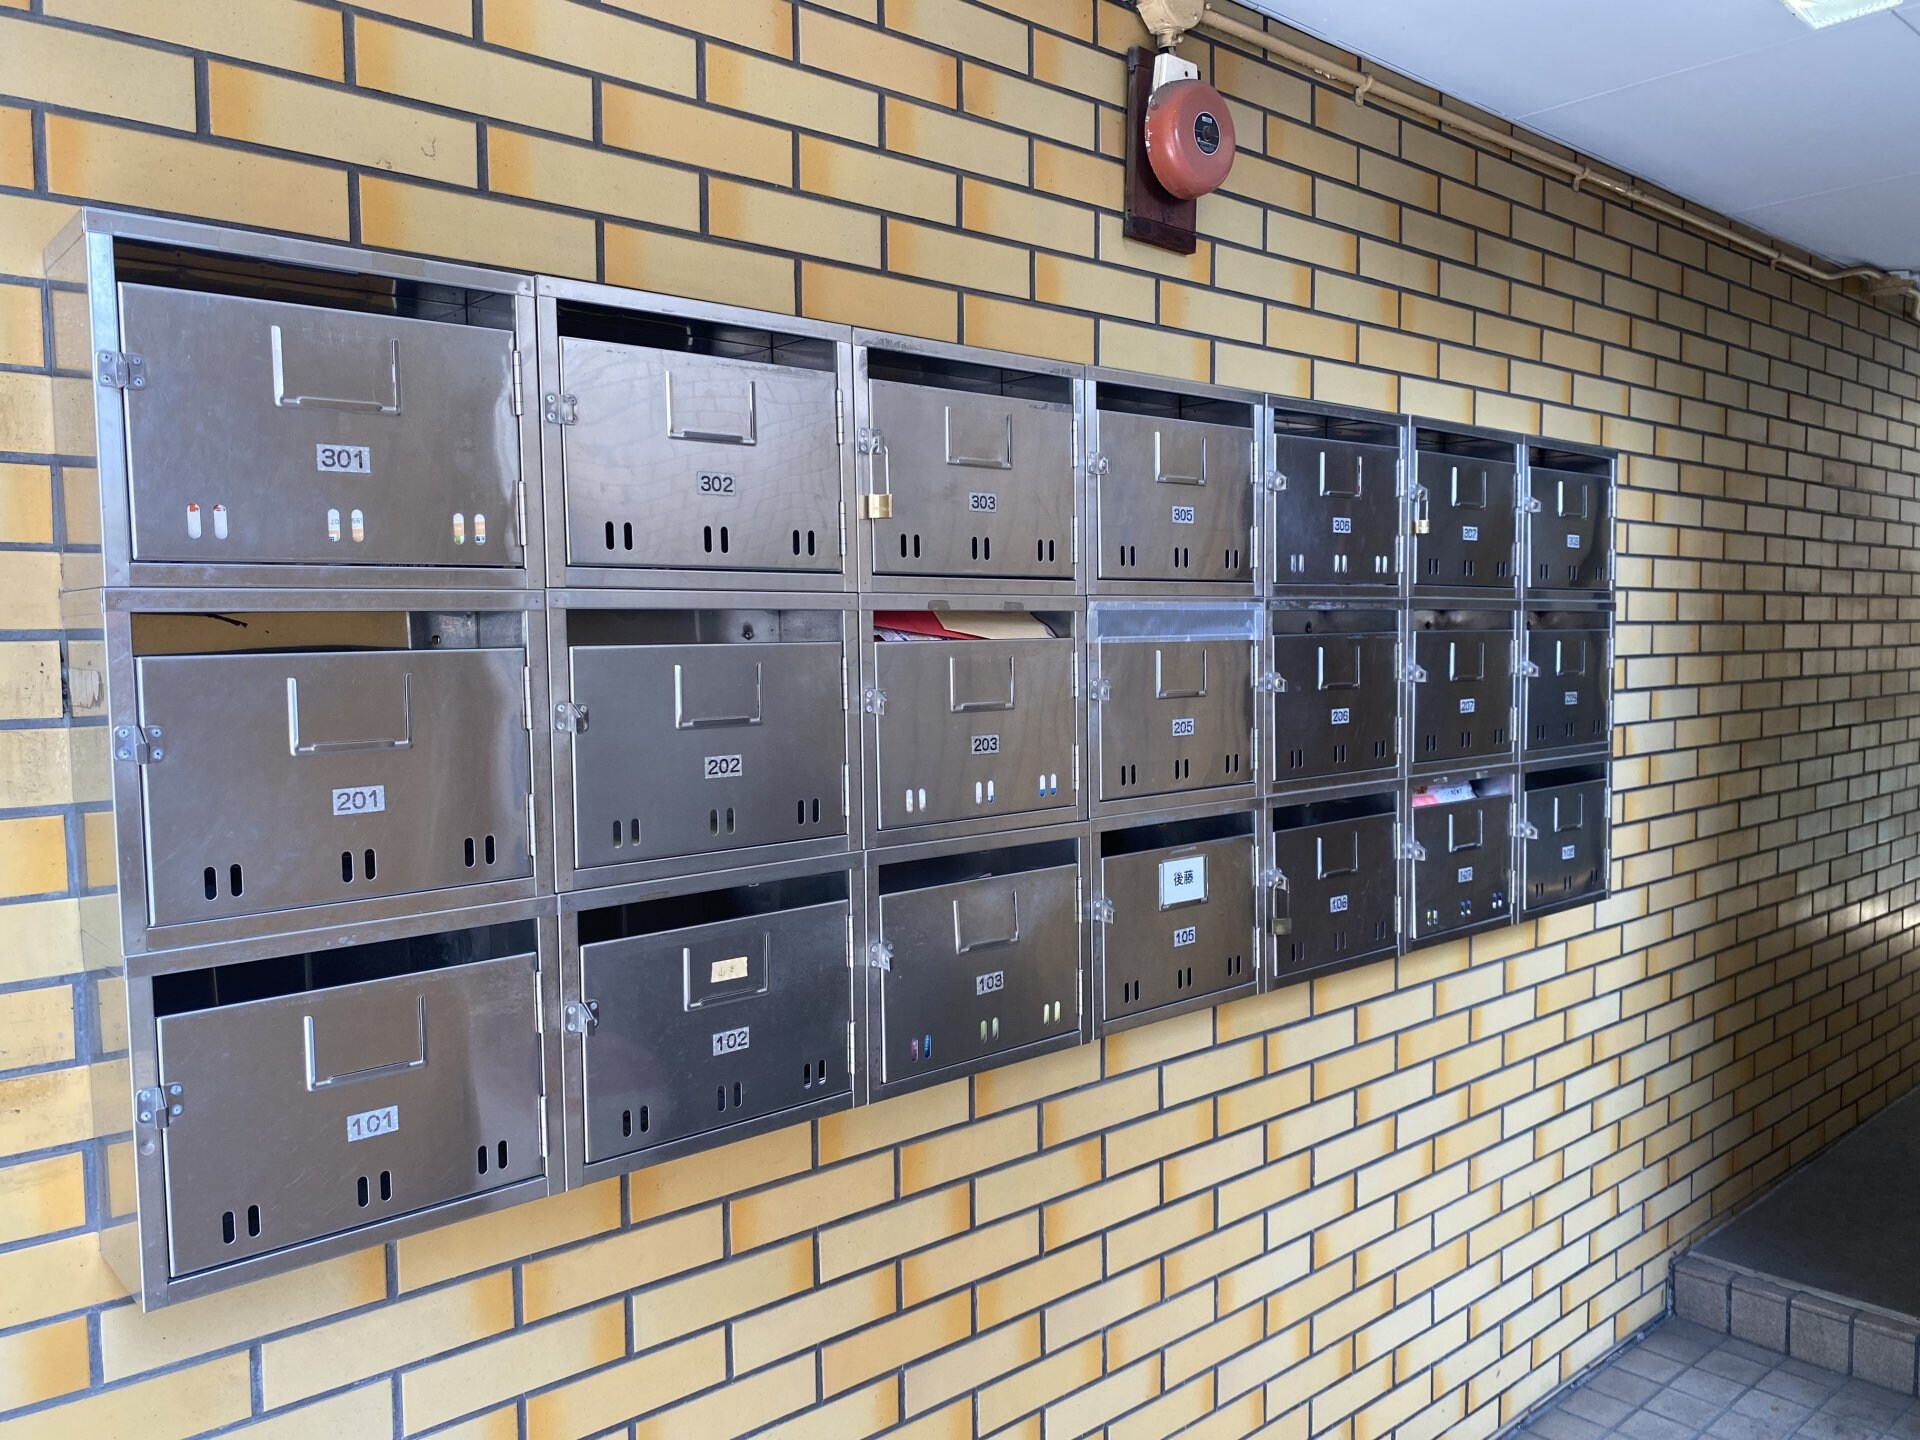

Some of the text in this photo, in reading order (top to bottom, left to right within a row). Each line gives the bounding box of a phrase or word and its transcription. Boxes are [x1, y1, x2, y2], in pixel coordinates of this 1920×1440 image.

[321, 448, 364, 469] 301
[700, 475, 733, 492] 302
[971, 495, 996, 510] 303
[1174, 508, 1192, 521] 305
[1334, 520, 1350, 531] 306
[1464, 528, 1476, 539] 307
[1461, 701, 1474, 711] 207
[1333, 710, 1348, 721] 206
[1174, 721, 1193, 734] 205
[974, 738, 998, 751] 203
[708, 758, 740, 775] 202
[337, 790, 378, 811] 201
[1174, 870, 1193, 886] 後藤
[1332, 897, 1347, 910] 106
[1176, 929, 1194, 943] 105
[979, 974, 1002, 991] 103
[716, 1031, 748, 1051] 102
[352, 1110, 392, 1136] 101
